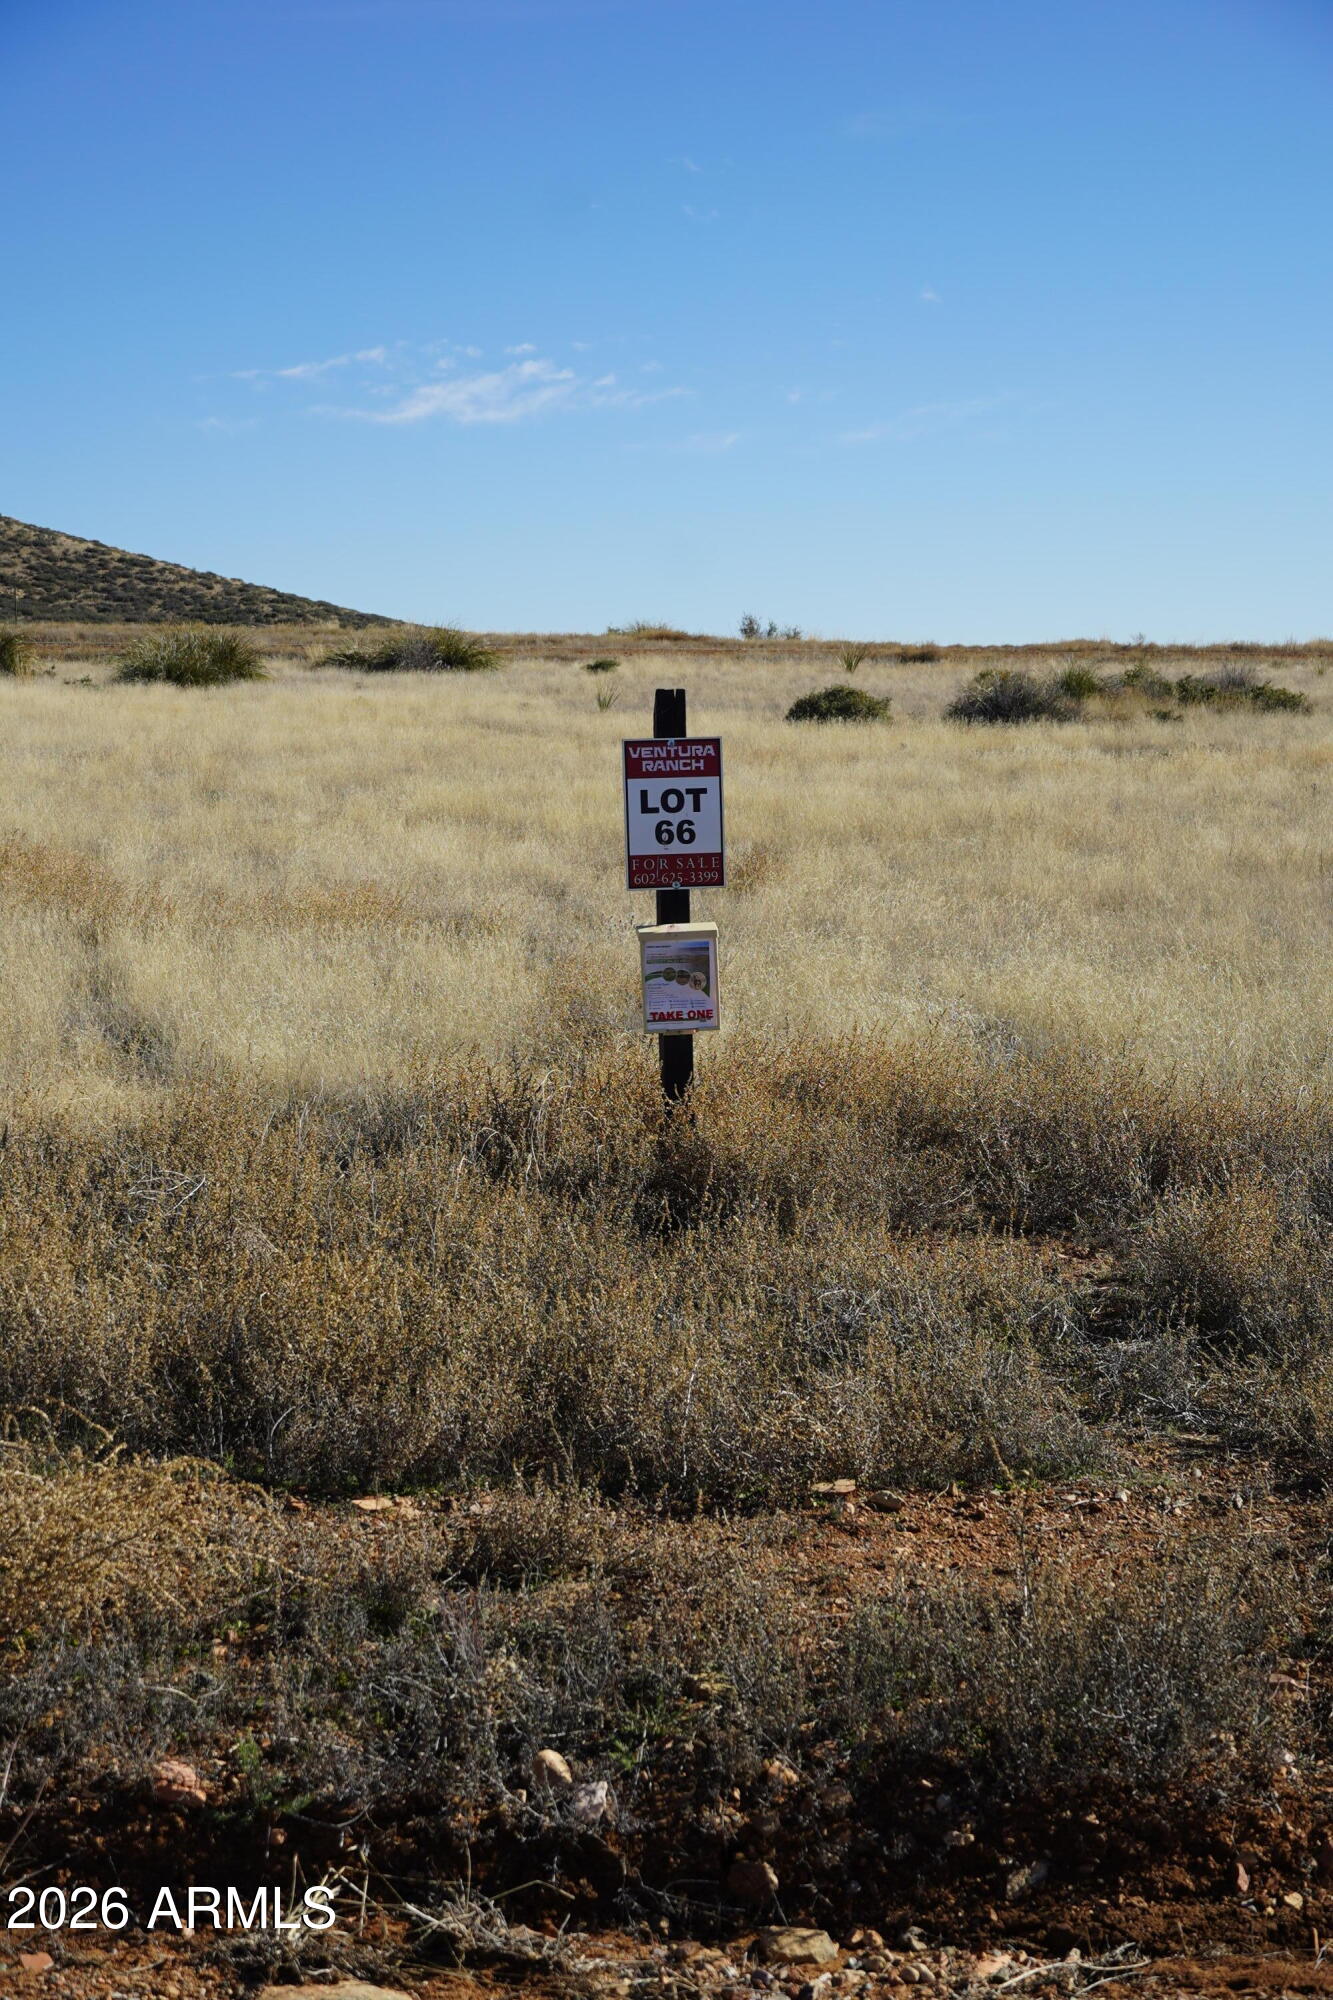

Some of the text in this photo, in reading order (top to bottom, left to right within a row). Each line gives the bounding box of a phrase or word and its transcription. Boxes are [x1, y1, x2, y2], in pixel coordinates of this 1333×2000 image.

[628, 745, 716, 759] VENTURA
[642, 759, 705, 772] RANCH
[639, 788, 708, 814] LOT
[655, 819, 696, 845] 66
[632, 857, 720, 870] FOR SALE
[650, 1009, 714, 1021] TAKE ONE
